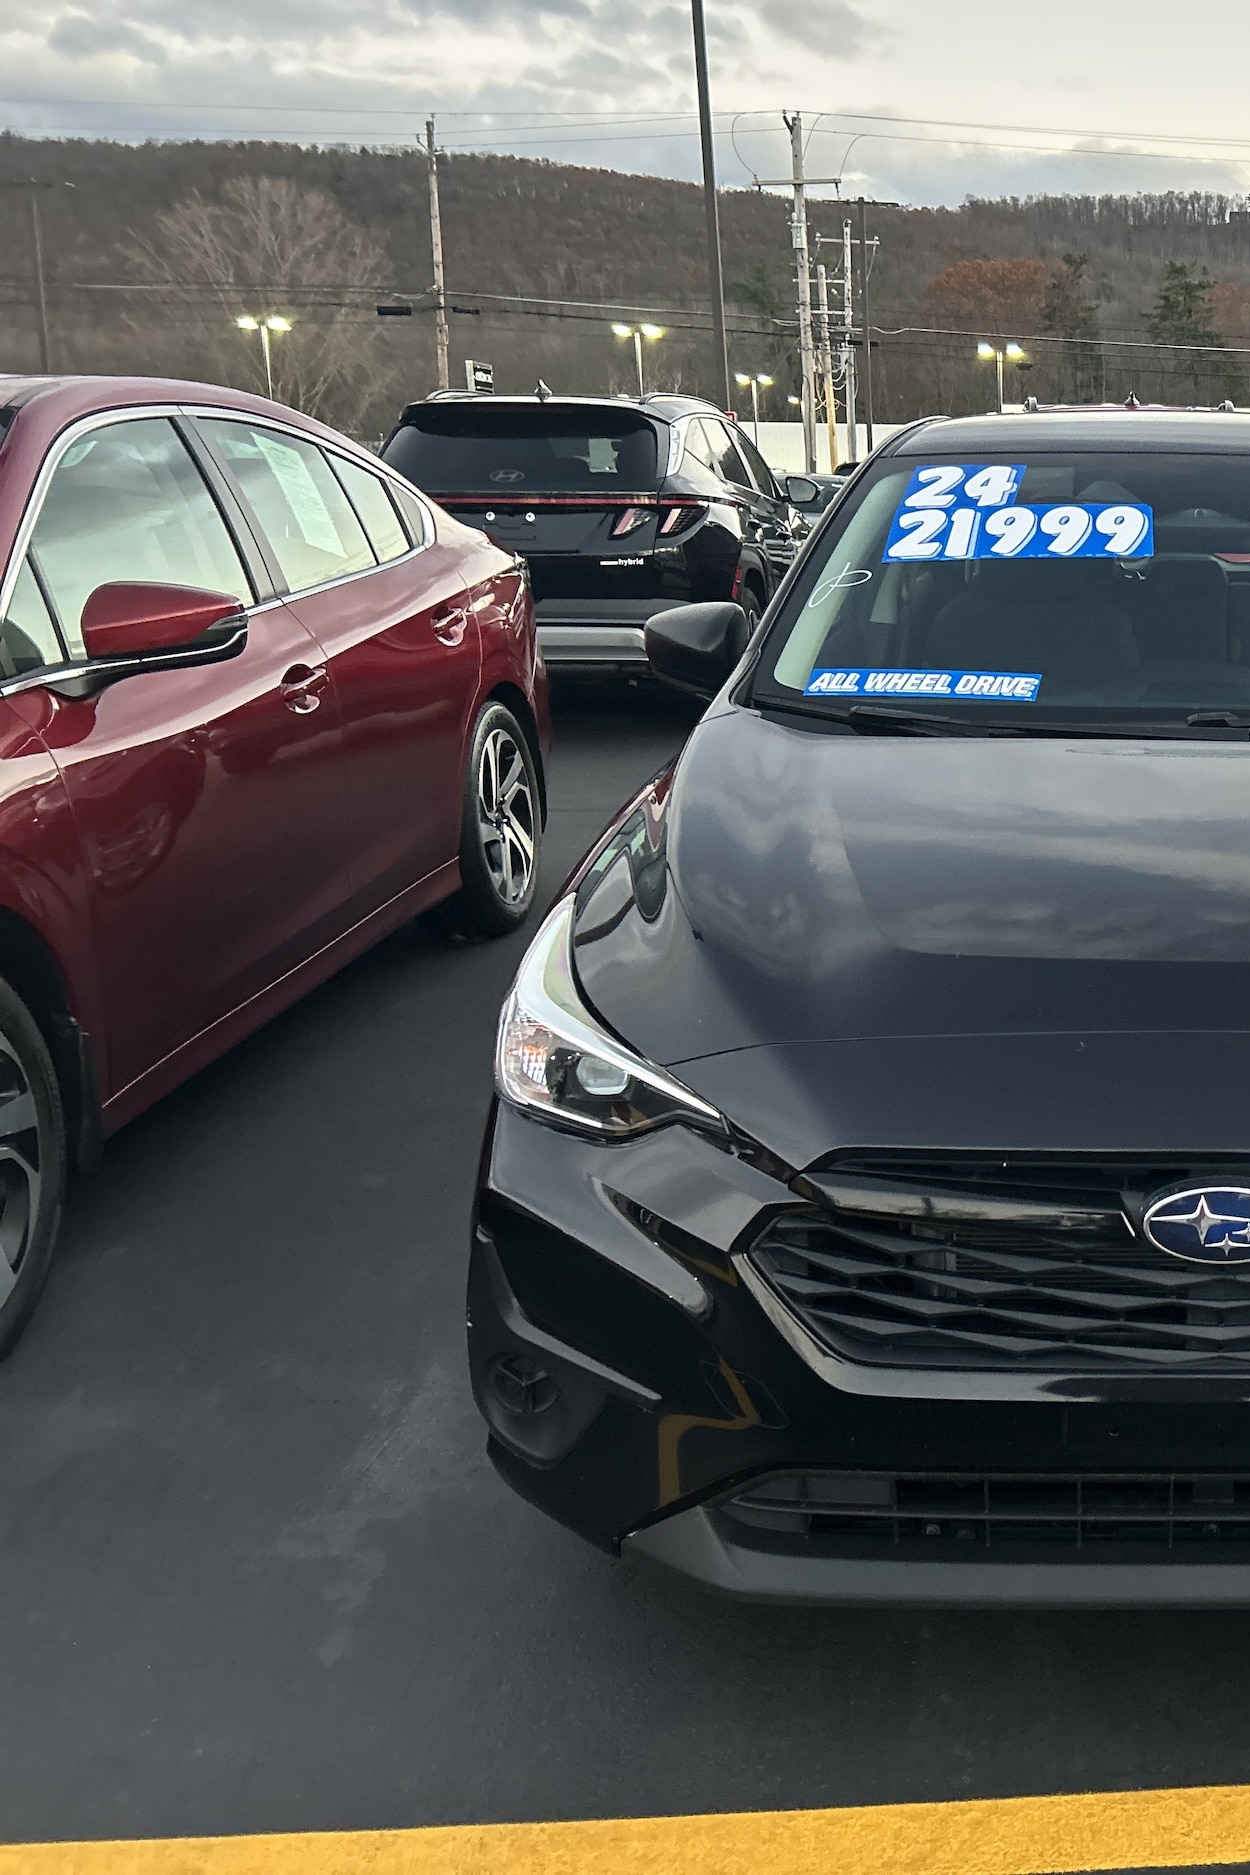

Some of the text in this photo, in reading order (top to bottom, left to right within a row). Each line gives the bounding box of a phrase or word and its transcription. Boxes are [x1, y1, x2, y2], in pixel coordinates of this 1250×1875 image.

[904, 466, 1017, 508] 24
[888, 506, 1149, 559] 21999
[618, 558, 644, 567] hybrid
[808, 672, 1038, 697] ALL WHEEL DRIVE
